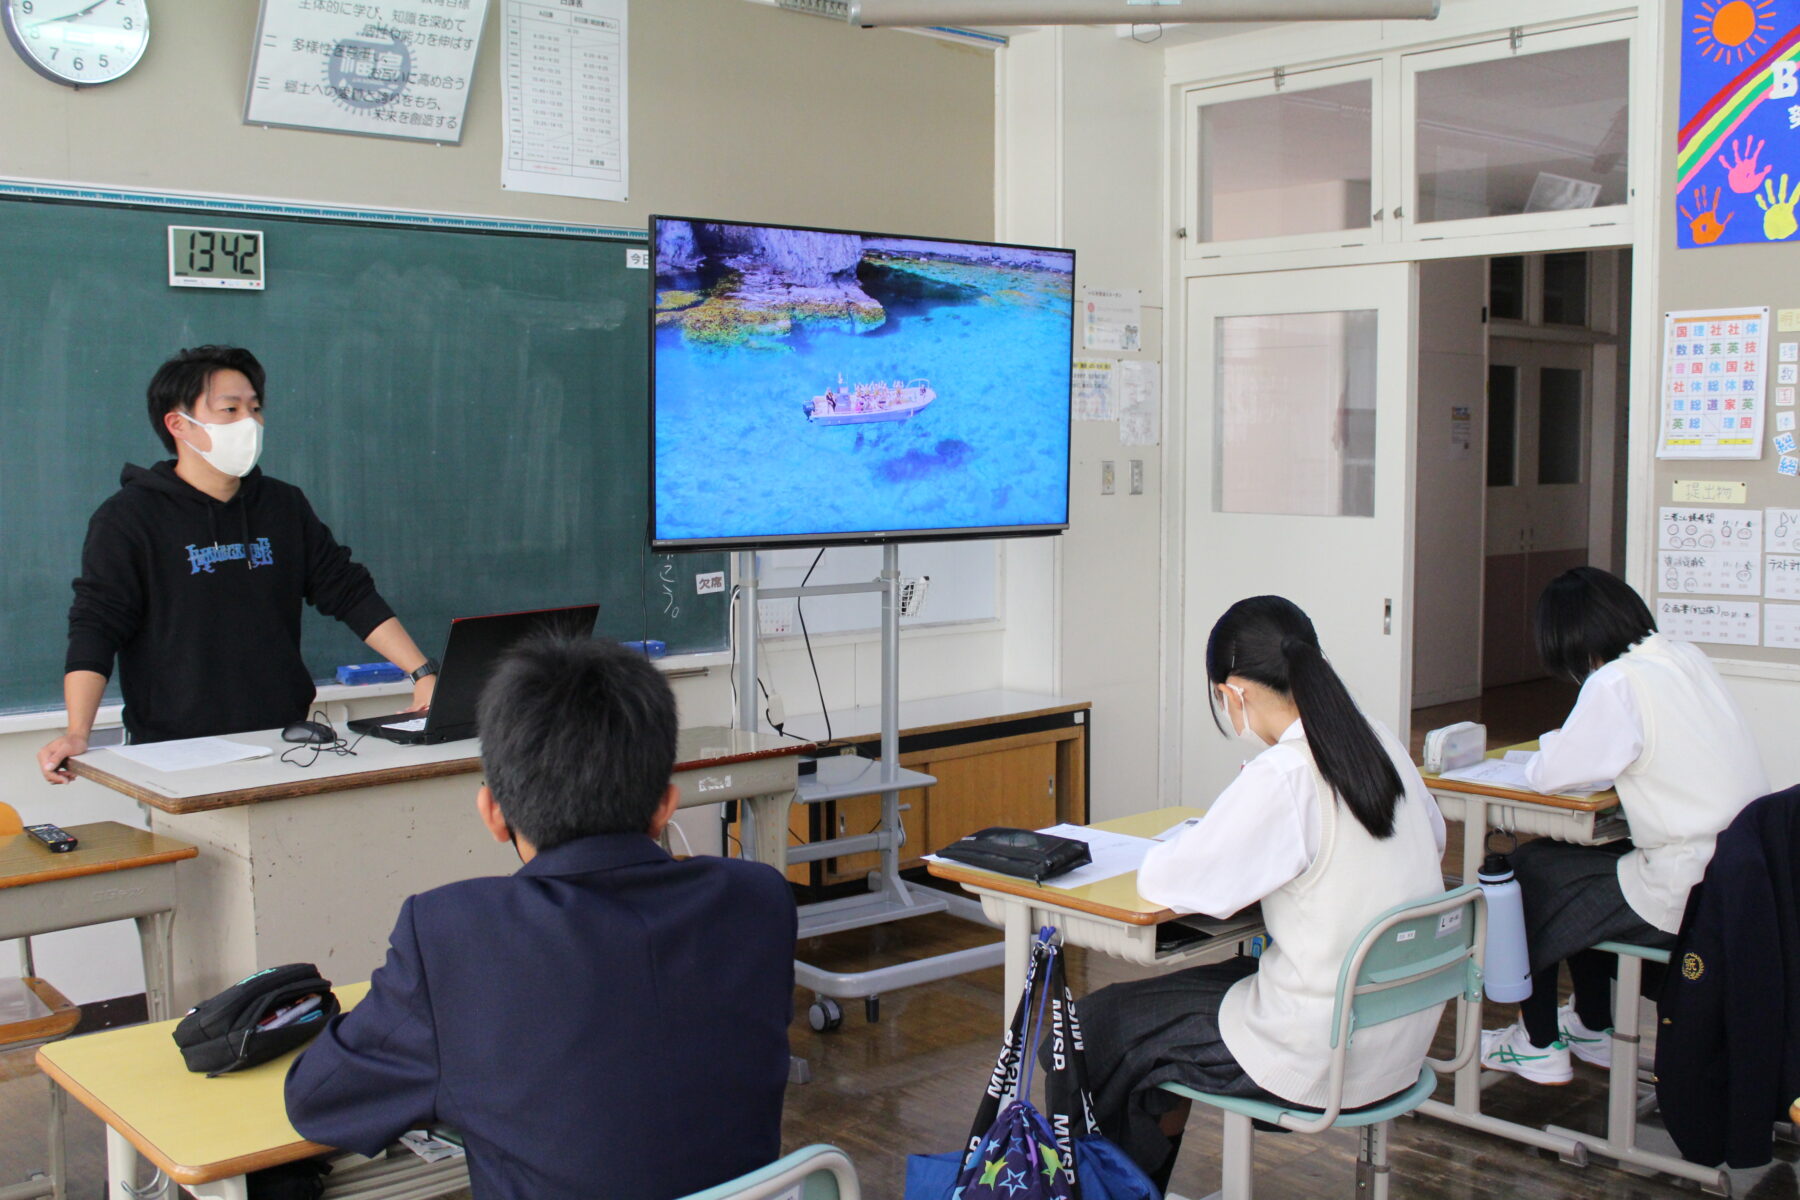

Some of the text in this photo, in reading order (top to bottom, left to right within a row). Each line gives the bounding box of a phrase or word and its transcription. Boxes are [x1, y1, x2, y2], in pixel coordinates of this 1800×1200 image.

[22, 1, 33, 14] 9
[122, 16, 133, 30] 3
[49, 46, 59, 60] 7
[73, 57, 84, 71] 6
[99, 54, 109, 68] 5
[1710, 324, 1721, 336] 社
[1728, 323, 1739, 335] 社
[1676, 344, 1687, 355] 数
[1693, 344, 1704, 355] 数
[1710, 343, 1721, 355] 英
[1728, 342, 1739, 353] 英
[1744, 360, 1755, 372] 社
[1673, 381, 1684, 392] 社
[1743, 380, 1754, 391] 数
[1742, 399, 1753, 410] 英
[1672, 418, 1683, 429] 英
[699, 576, 722, 590] 欠席
